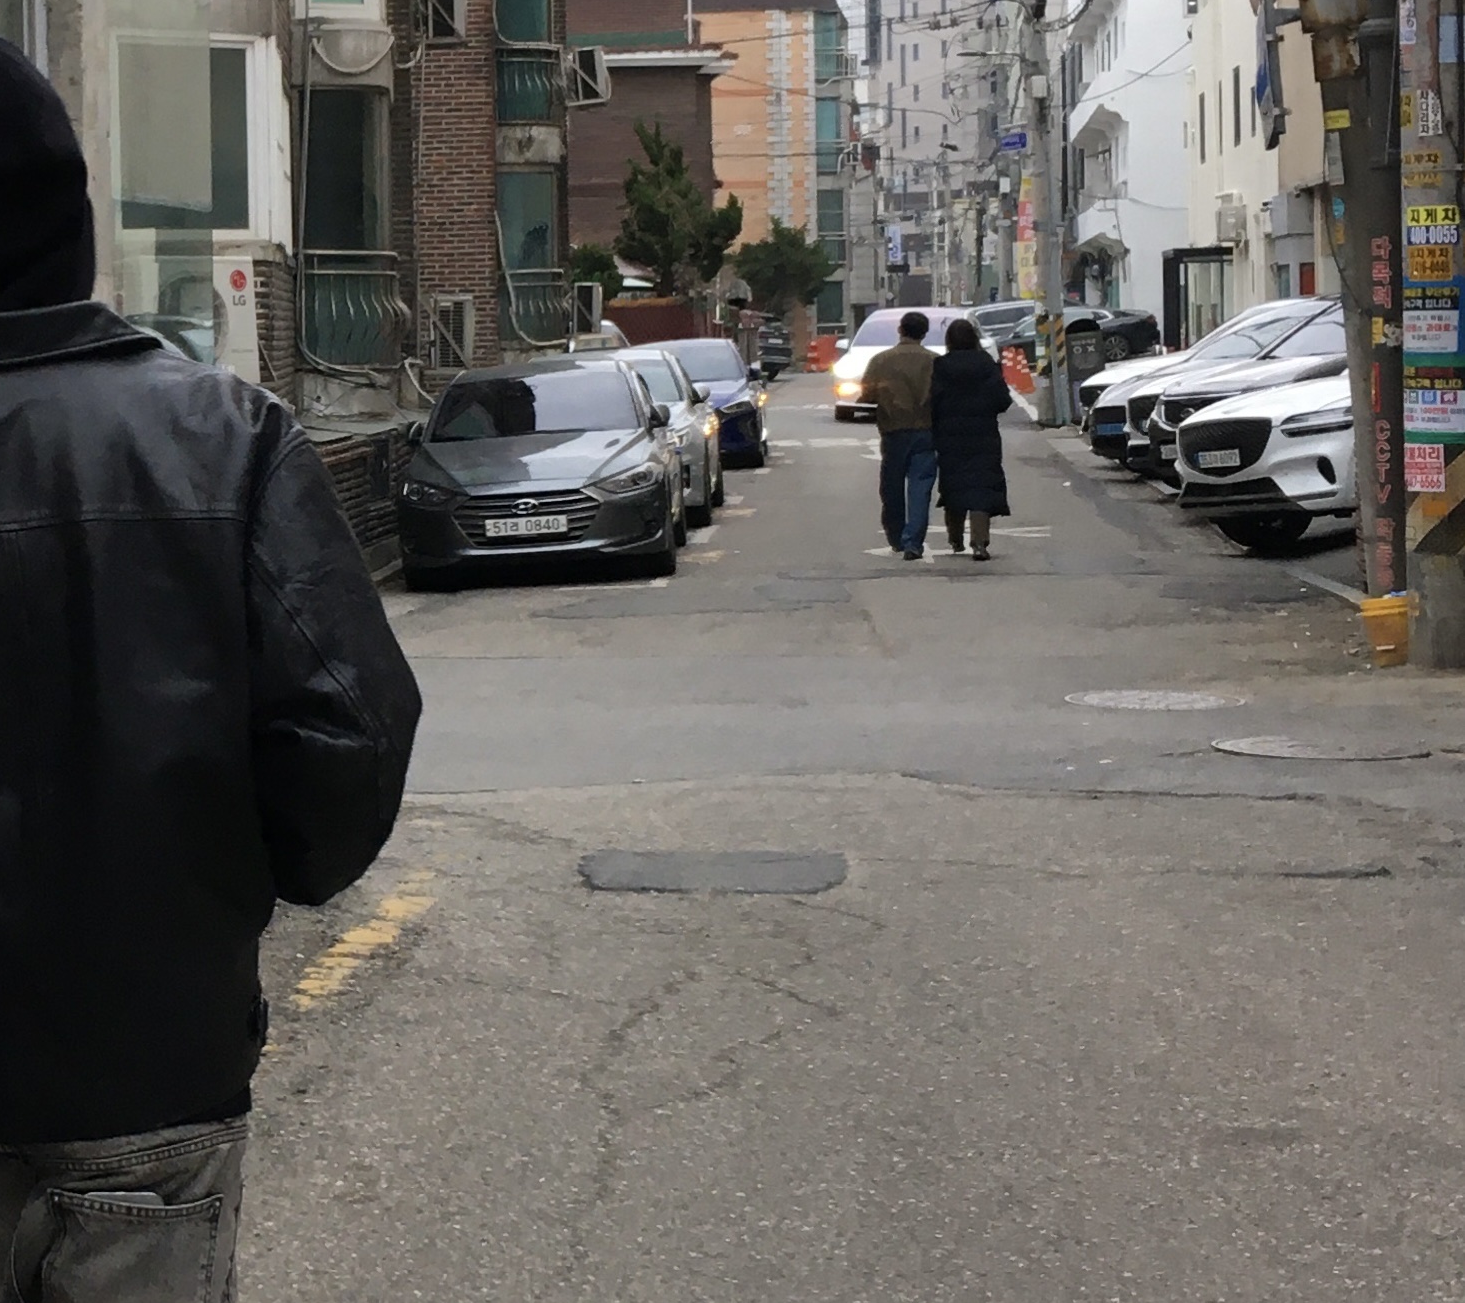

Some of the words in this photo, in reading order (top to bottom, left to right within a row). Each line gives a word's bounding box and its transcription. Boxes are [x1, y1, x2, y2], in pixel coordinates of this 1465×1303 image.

[1410, 225, 1458, 245] 400-0055
[232, 294, 247, 307] LG
[1375, 419, 1392, 504] CCTV
[525, 517, 560, 532] 0840
